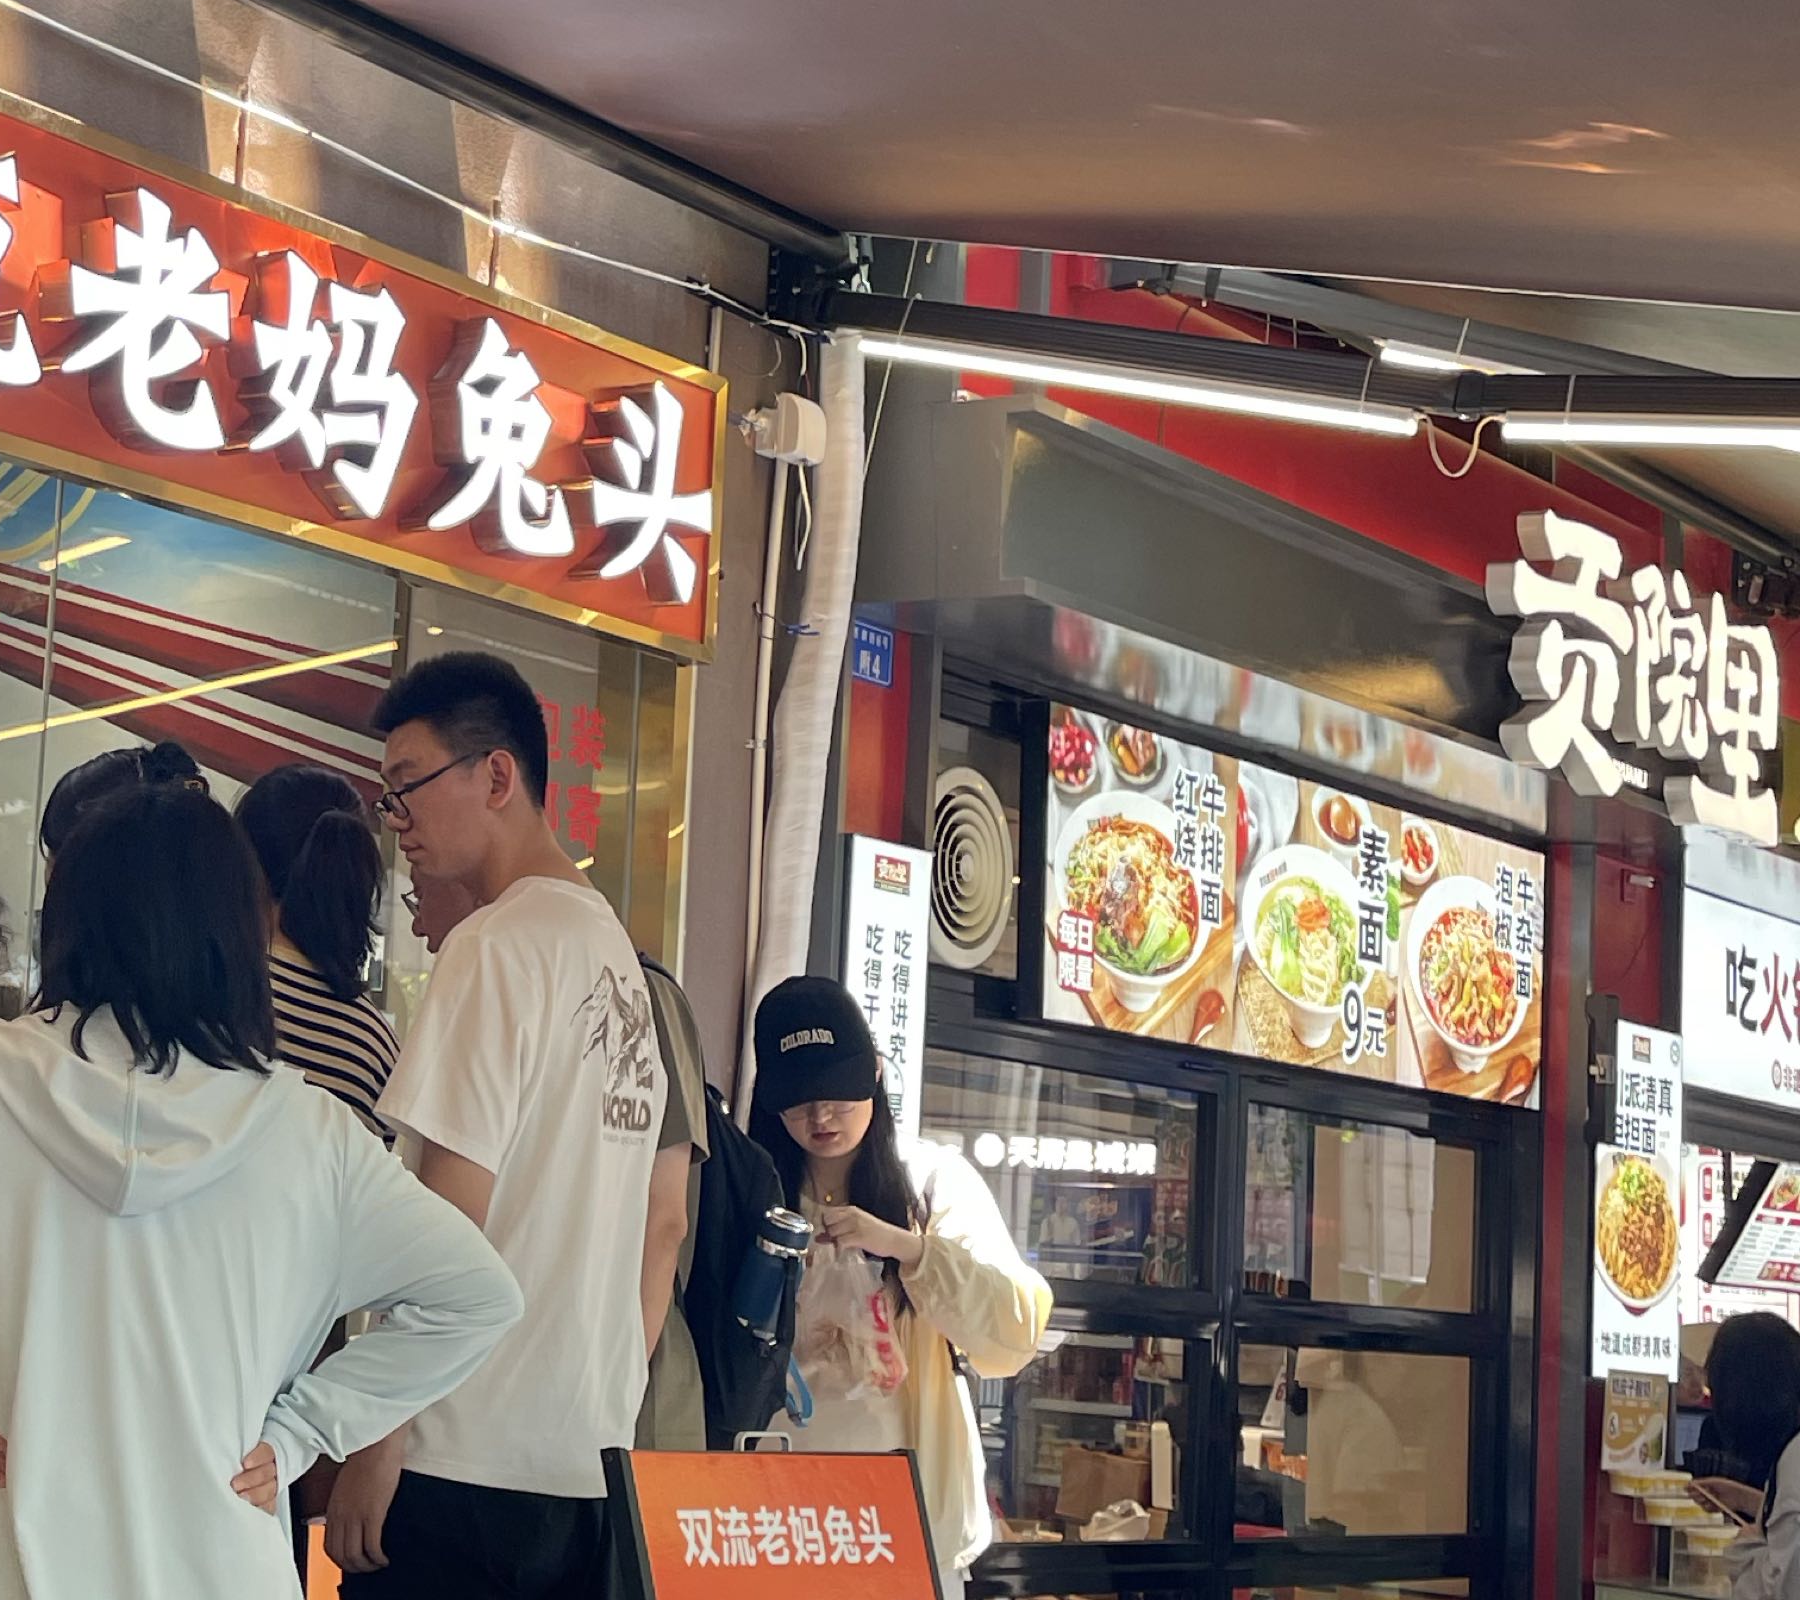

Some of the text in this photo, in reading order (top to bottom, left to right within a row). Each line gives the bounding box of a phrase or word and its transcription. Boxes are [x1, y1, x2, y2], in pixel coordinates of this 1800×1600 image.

[1513, 508, 1779, 848] 贡院里
[1173, 768, 1198, 867] 红烧
[1201, 775, 1225, 924] 牛排面
[1059, 912, 1093, 953] 每日
[1358, 828, 1387, 965] 素面
[1495, 865, 1514, 951] 泡椒
[1516, 871, 1534, 999] 牛杂面
[1057, 951, 1093, 992] 限量
[1343, 988, 1386, 1058] 9元
[676, 1504, 896, 1569] 双流老妈兔头
